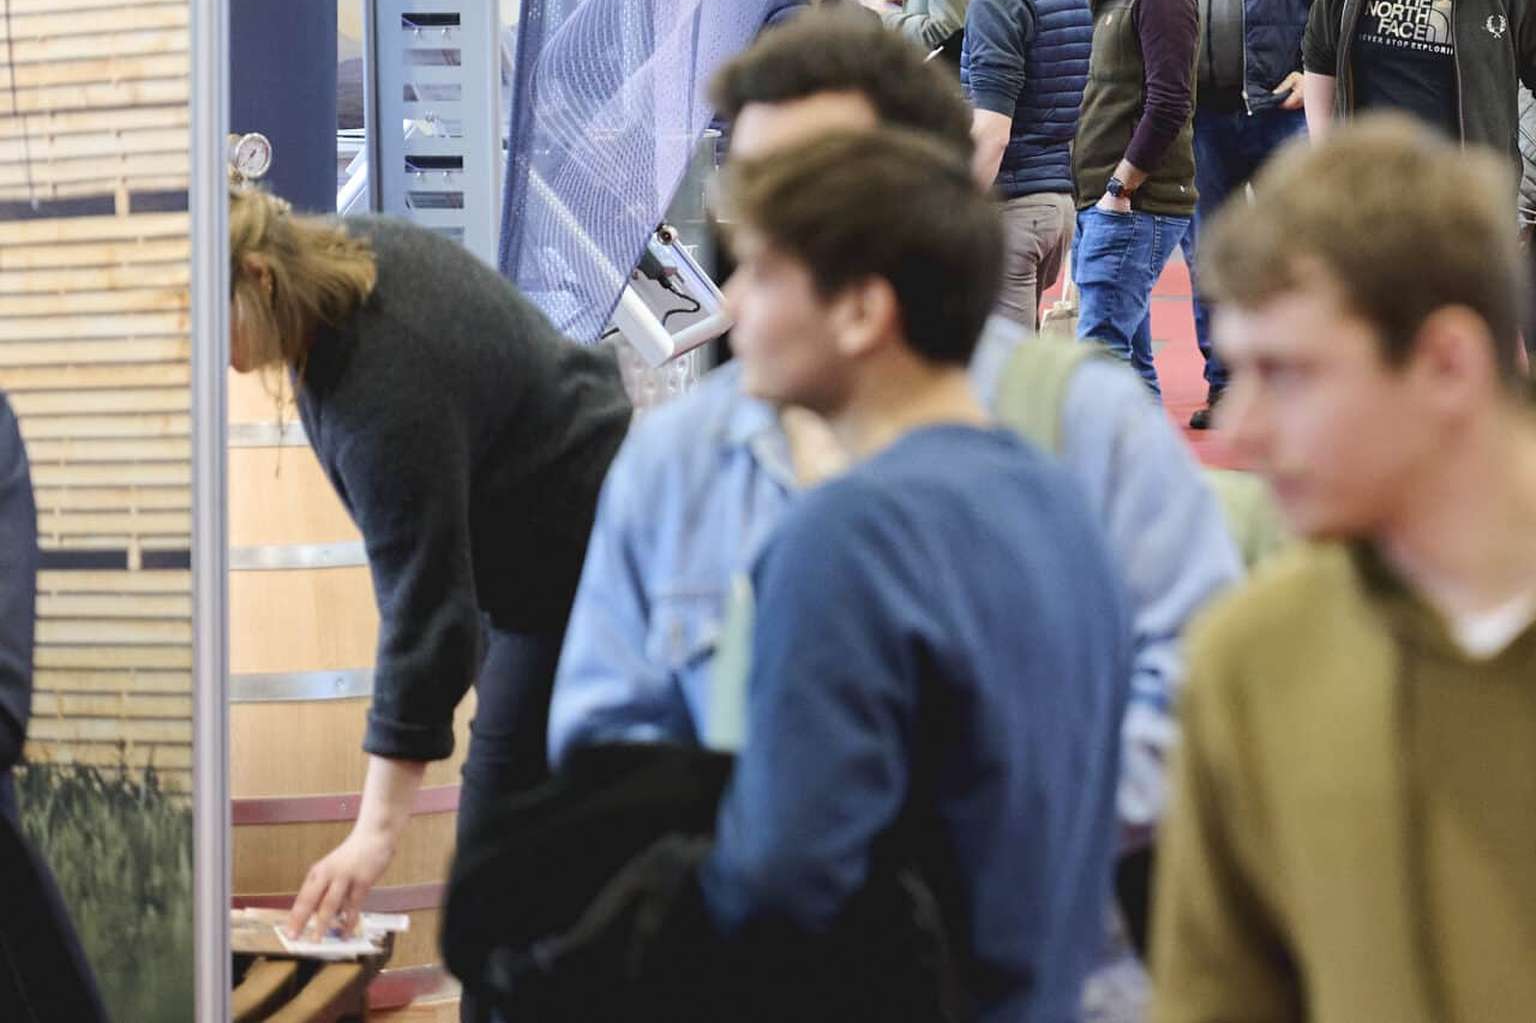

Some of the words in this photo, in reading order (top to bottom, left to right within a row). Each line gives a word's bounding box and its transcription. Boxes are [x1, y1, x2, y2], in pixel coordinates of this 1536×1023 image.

[1365, 0, 1430, 24] NORTH
[1360, 33, 1383, 45] EVER
[1377, 18, 1427, 42] FACE
